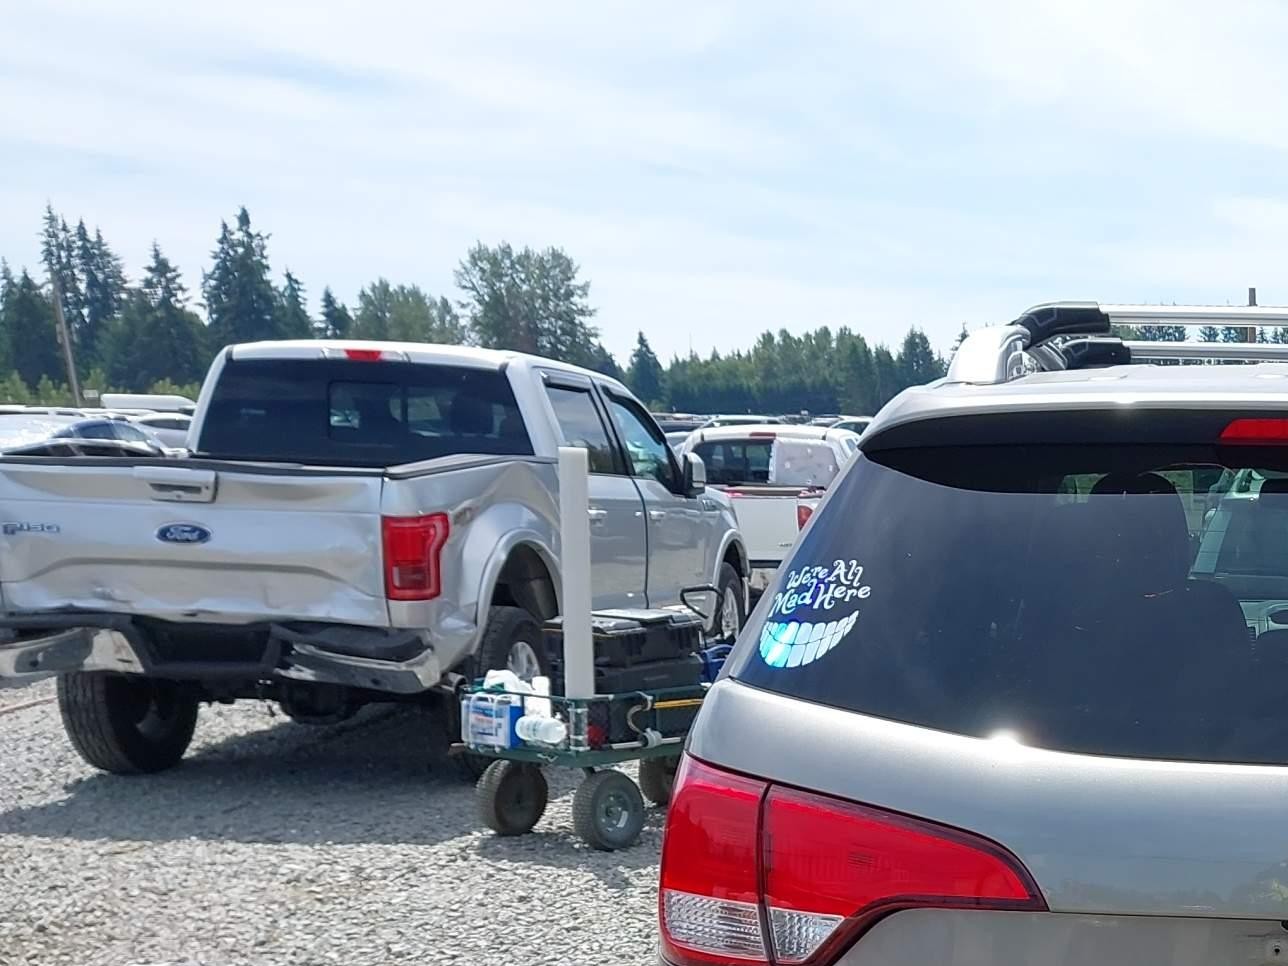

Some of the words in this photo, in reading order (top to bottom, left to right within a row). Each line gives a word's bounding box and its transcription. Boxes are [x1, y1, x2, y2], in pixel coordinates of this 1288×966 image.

[786, 566, 828, 589] We're
[824, 559, 863, 587] All
[768, 578, 817, 618] Mad
[812, 583, 871, 610] Here
